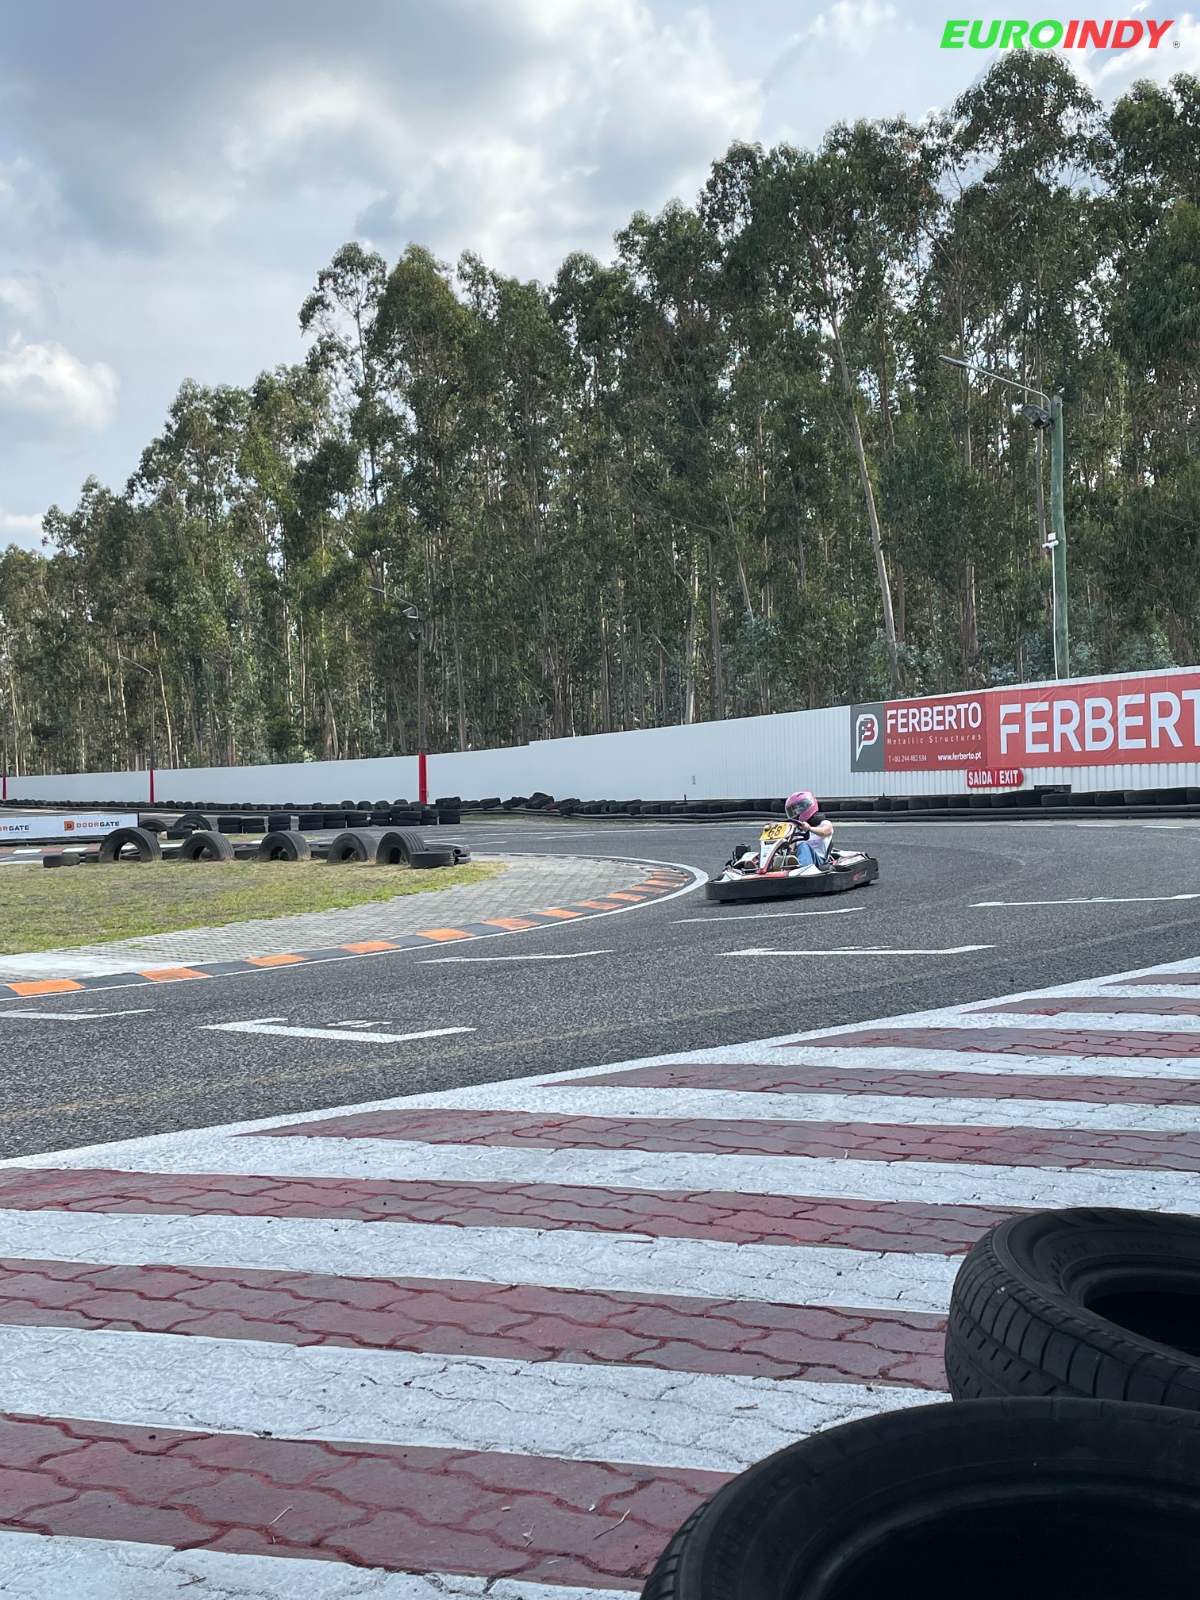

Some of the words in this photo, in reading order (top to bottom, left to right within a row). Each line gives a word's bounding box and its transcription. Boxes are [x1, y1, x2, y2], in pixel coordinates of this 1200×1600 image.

[886, 702, 982, 734] FERBERTO
[1000, 688, 1200, 755] FERBERT
[928, 734, 982, 744] Structures
[937, 751, 982, 761] www.ferberto.pt
[968, 769, 993, 786] SAÍDA
[999, 769, 1019, 785] EXIT
